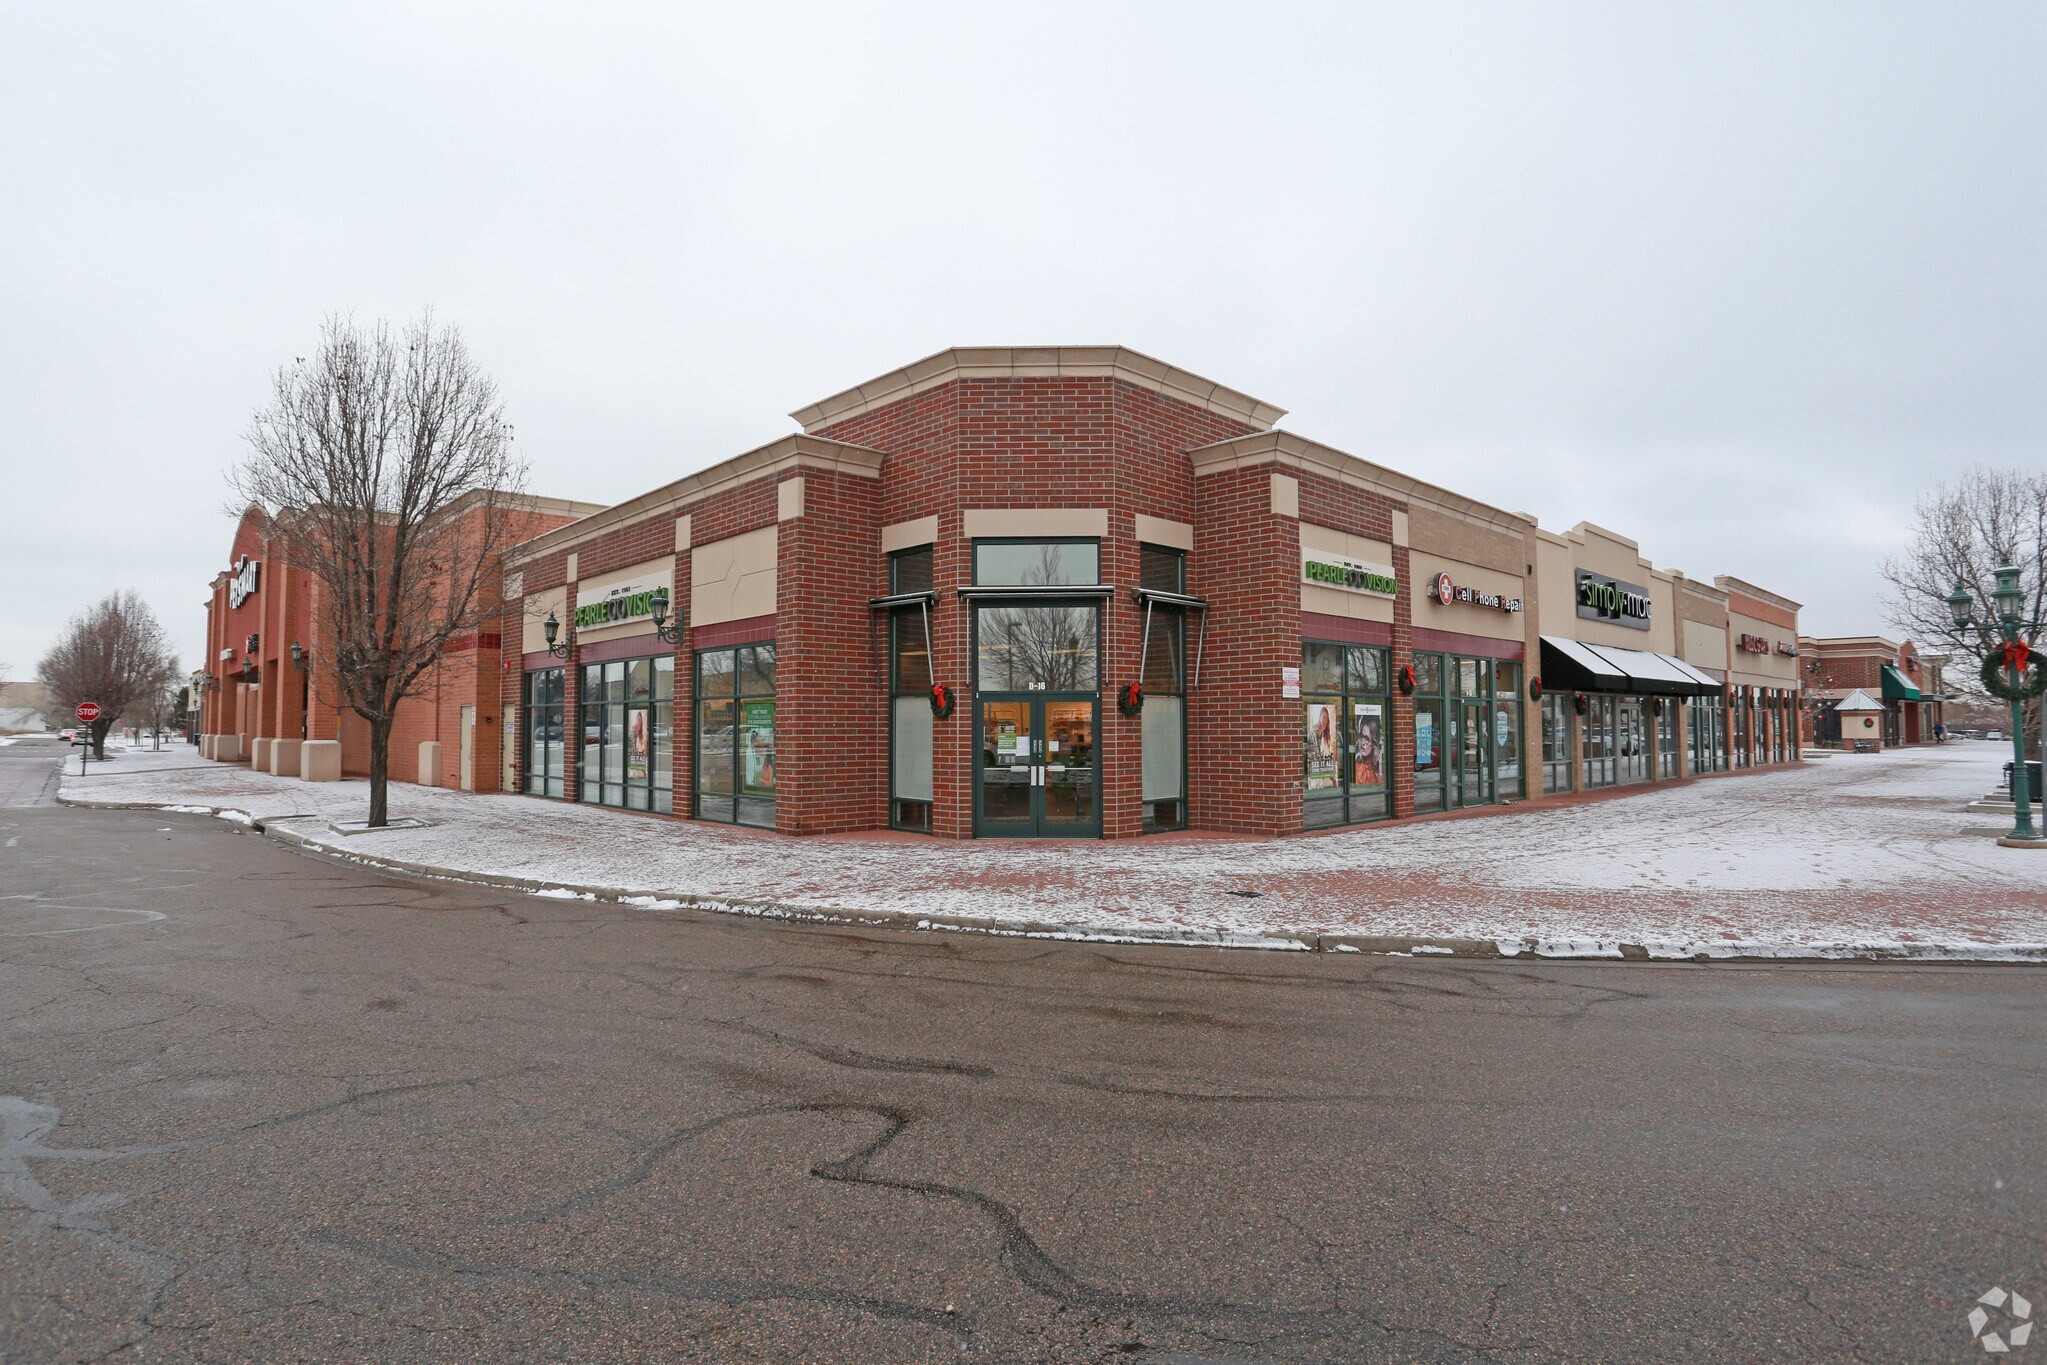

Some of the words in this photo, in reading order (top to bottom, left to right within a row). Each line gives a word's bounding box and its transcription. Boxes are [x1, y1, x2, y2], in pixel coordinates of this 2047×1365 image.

[1307, 561, 1348, 585] PEARLE
[1366, 573, 1398, 594] VISION
[1455, 585, 1472, 602] Cell
[1474, 589, 1499, 608] Phone
[1501, 595, 1524, 613] Repair
[574, 601, 608, 627] PEARLE
[1028, 682, 1046, 690] D-16
